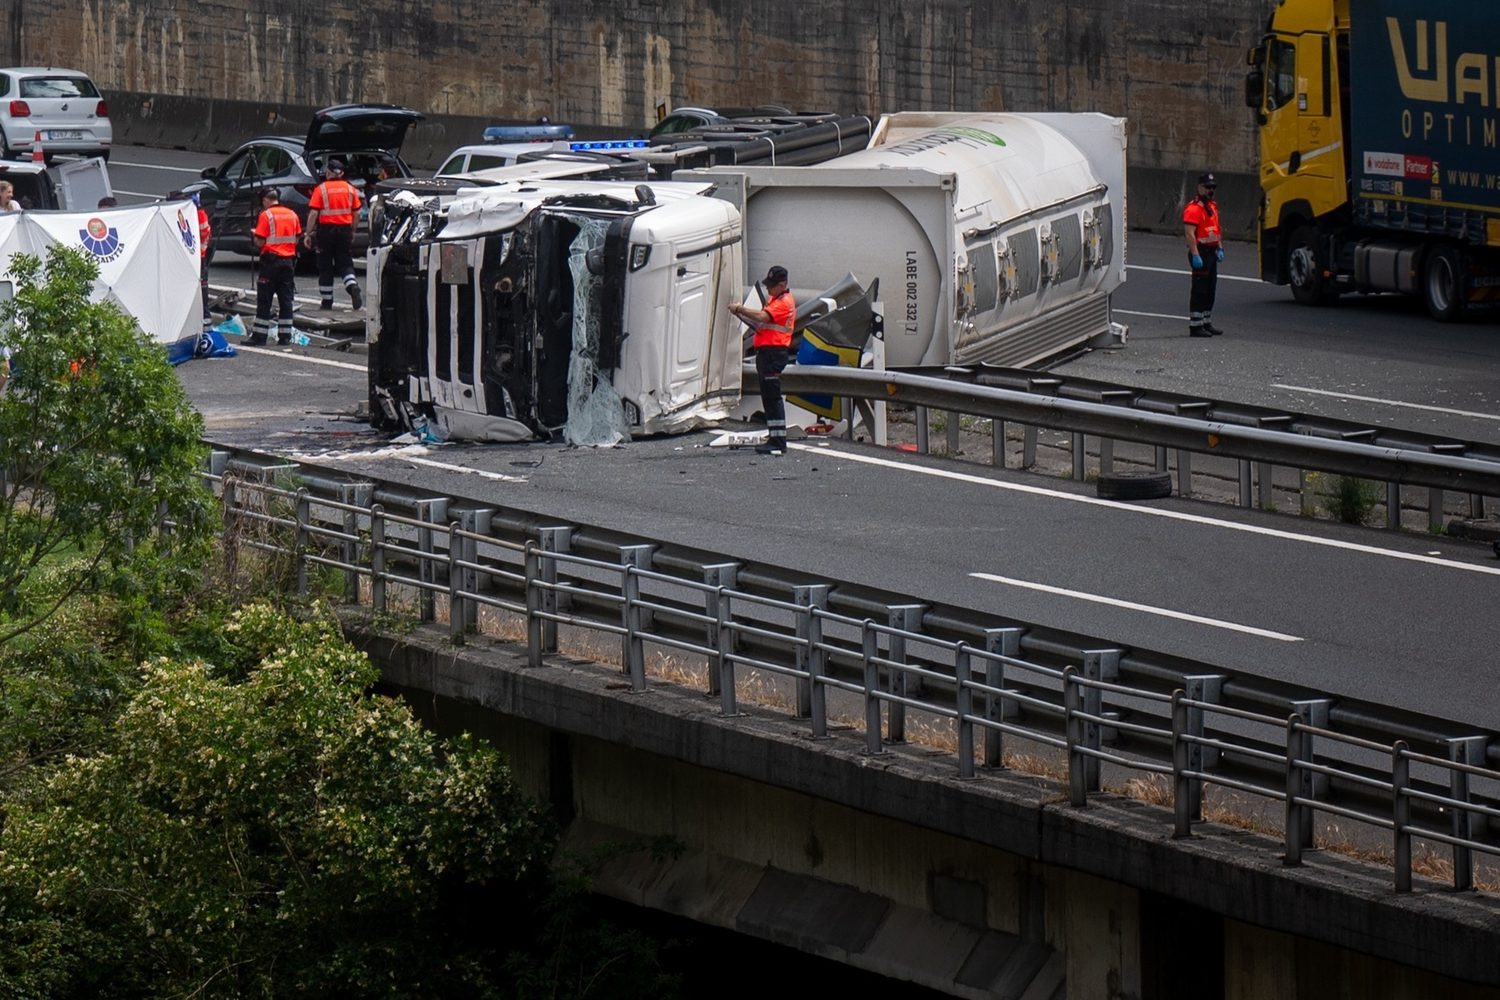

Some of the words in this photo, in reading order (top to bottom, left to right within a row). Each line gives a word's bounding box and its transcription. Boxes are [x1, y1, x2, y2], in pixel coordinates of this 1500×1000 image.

[1374, 157, 1401, 172] vodafone
[1405, 159, 1429, 175] Partner
[906, 250, 918, 280] LABE
[906, 281, 918, 301] 002
[906, 302, 918, 321] 332
